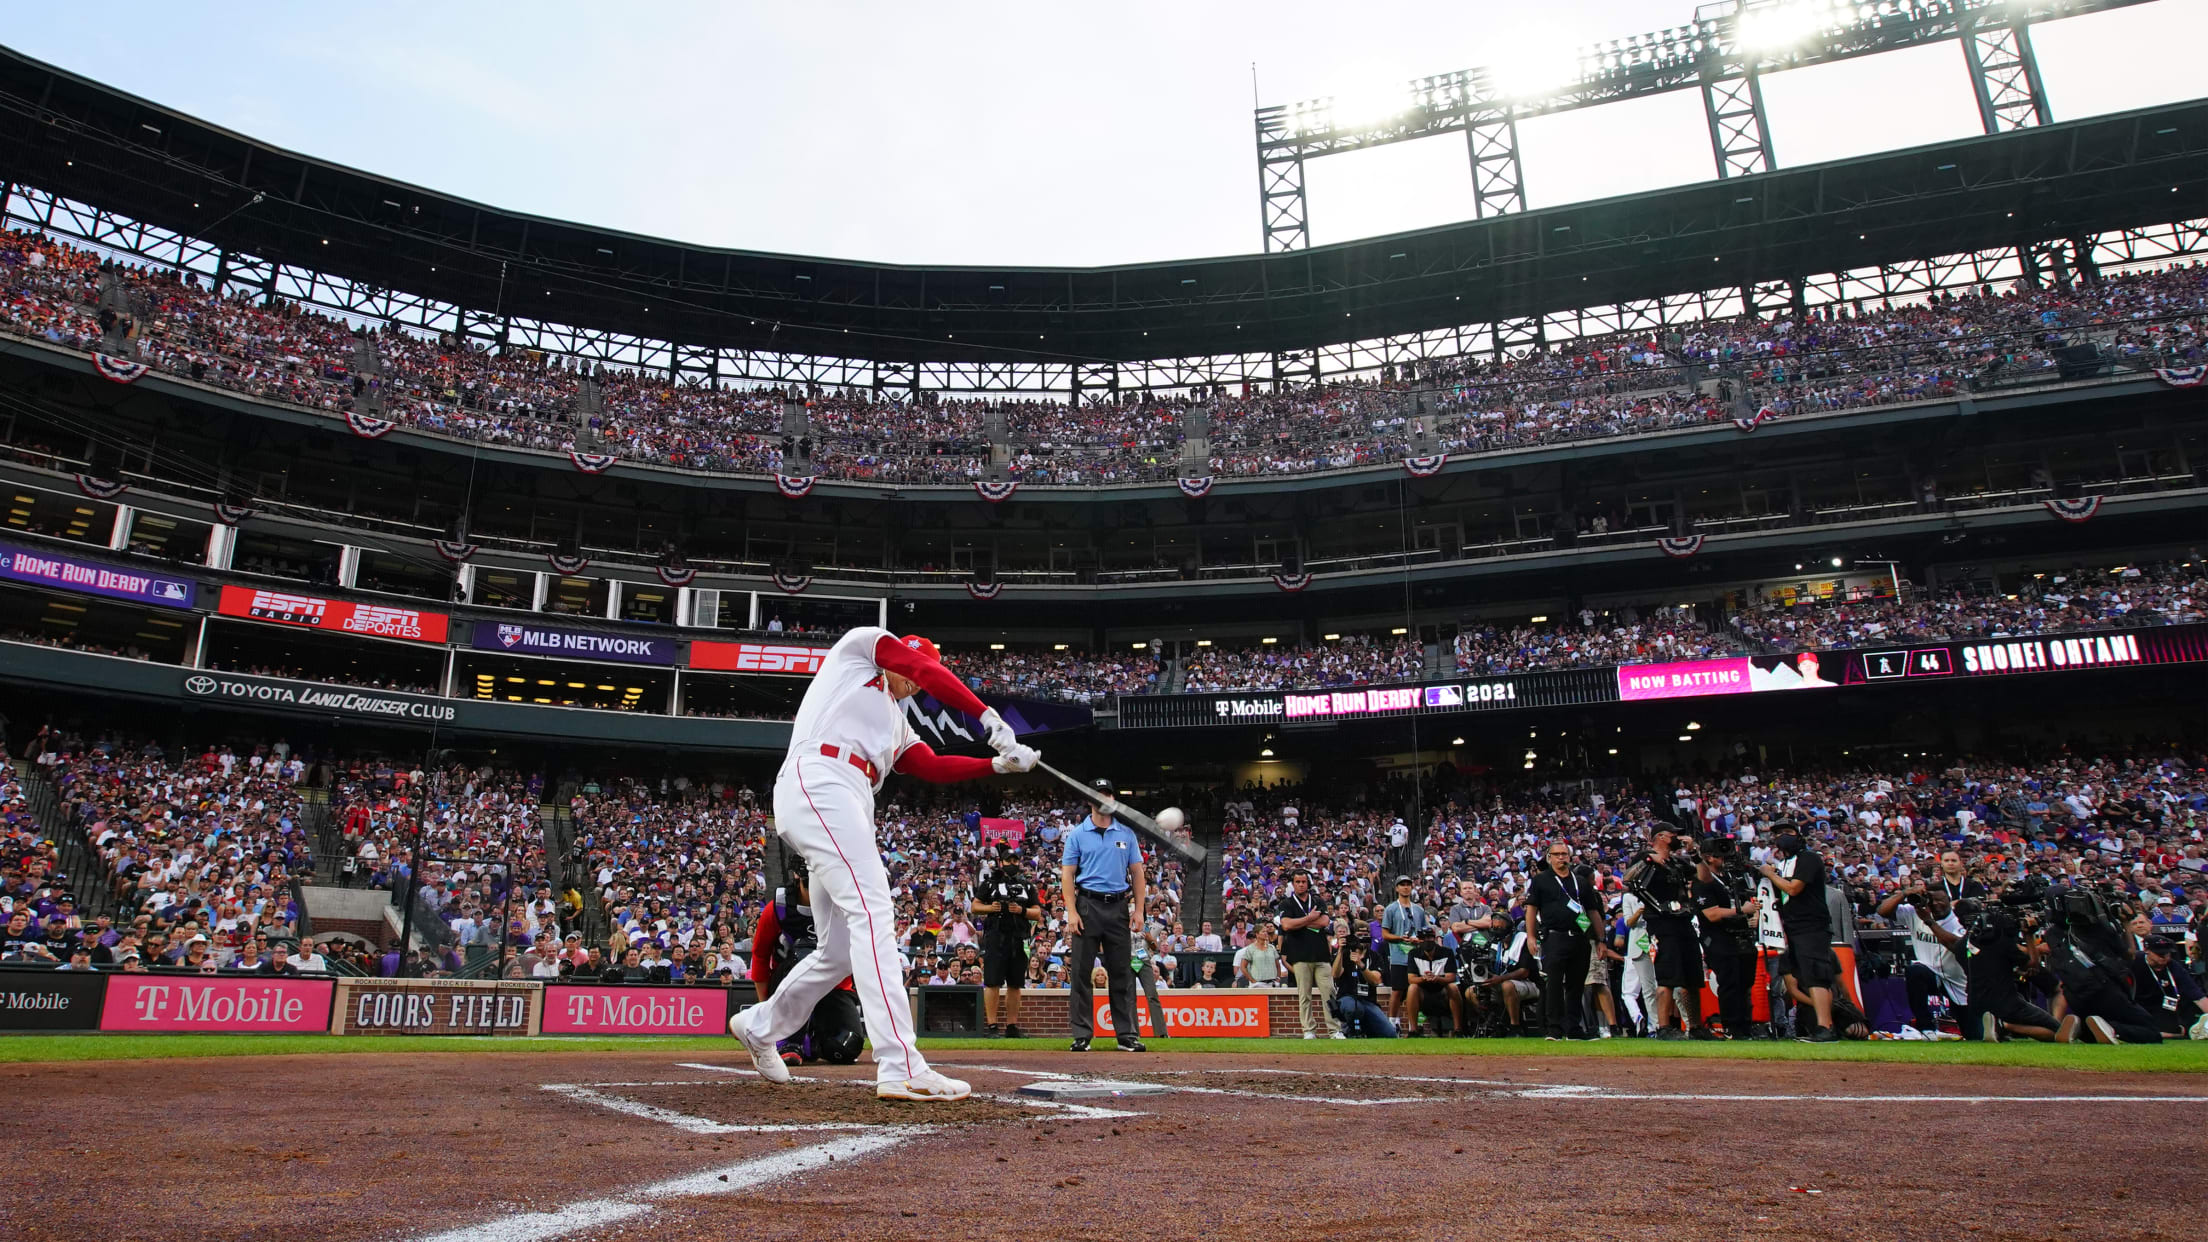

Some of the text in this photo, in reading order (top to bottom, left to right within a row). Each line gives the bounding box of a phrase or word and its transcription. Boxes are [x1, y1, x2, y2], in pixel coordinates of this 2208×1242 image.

[13, 553, 61, 578] HOME
[61, 563, 96, 585] RUN
[96, 569, 149, 595] DERBY
[252, 590, 326, 616] ESPN
[353, 604, 419, 627] ESPN
[251, 608, 319, 625] RADIO
[343, 618, 421, 638] DEPORTES
[523, 631, 652, 656] MLB NETWORK
[1962, 634, 2140, 672] SHOHEI OHTANI
[1920, 653, 1940, 671] 44
[1630, 670, 1741, 690] NOW BATTING
[220, 681, 295, 703] TOYOTA
[411, 703, 455, 720] CLUB
[1231, 698, 1283, 717] Mobile
[1284, 694, 1331, 717] HOME
[1331, 691, 1367, 715] RUN
[1367, 687, 1423, 713] DERBY
[1467, 683, 1516, 702] 2021
[6, 992, 69, 1010] Mobile
[174, 986, 304, 1023] Mobile
[357, 992, 524, 1028] COORS FIELD
[600, 995, 704, 1028] Mobile
[1136, 1007, 1259, 1028] GTORADE
